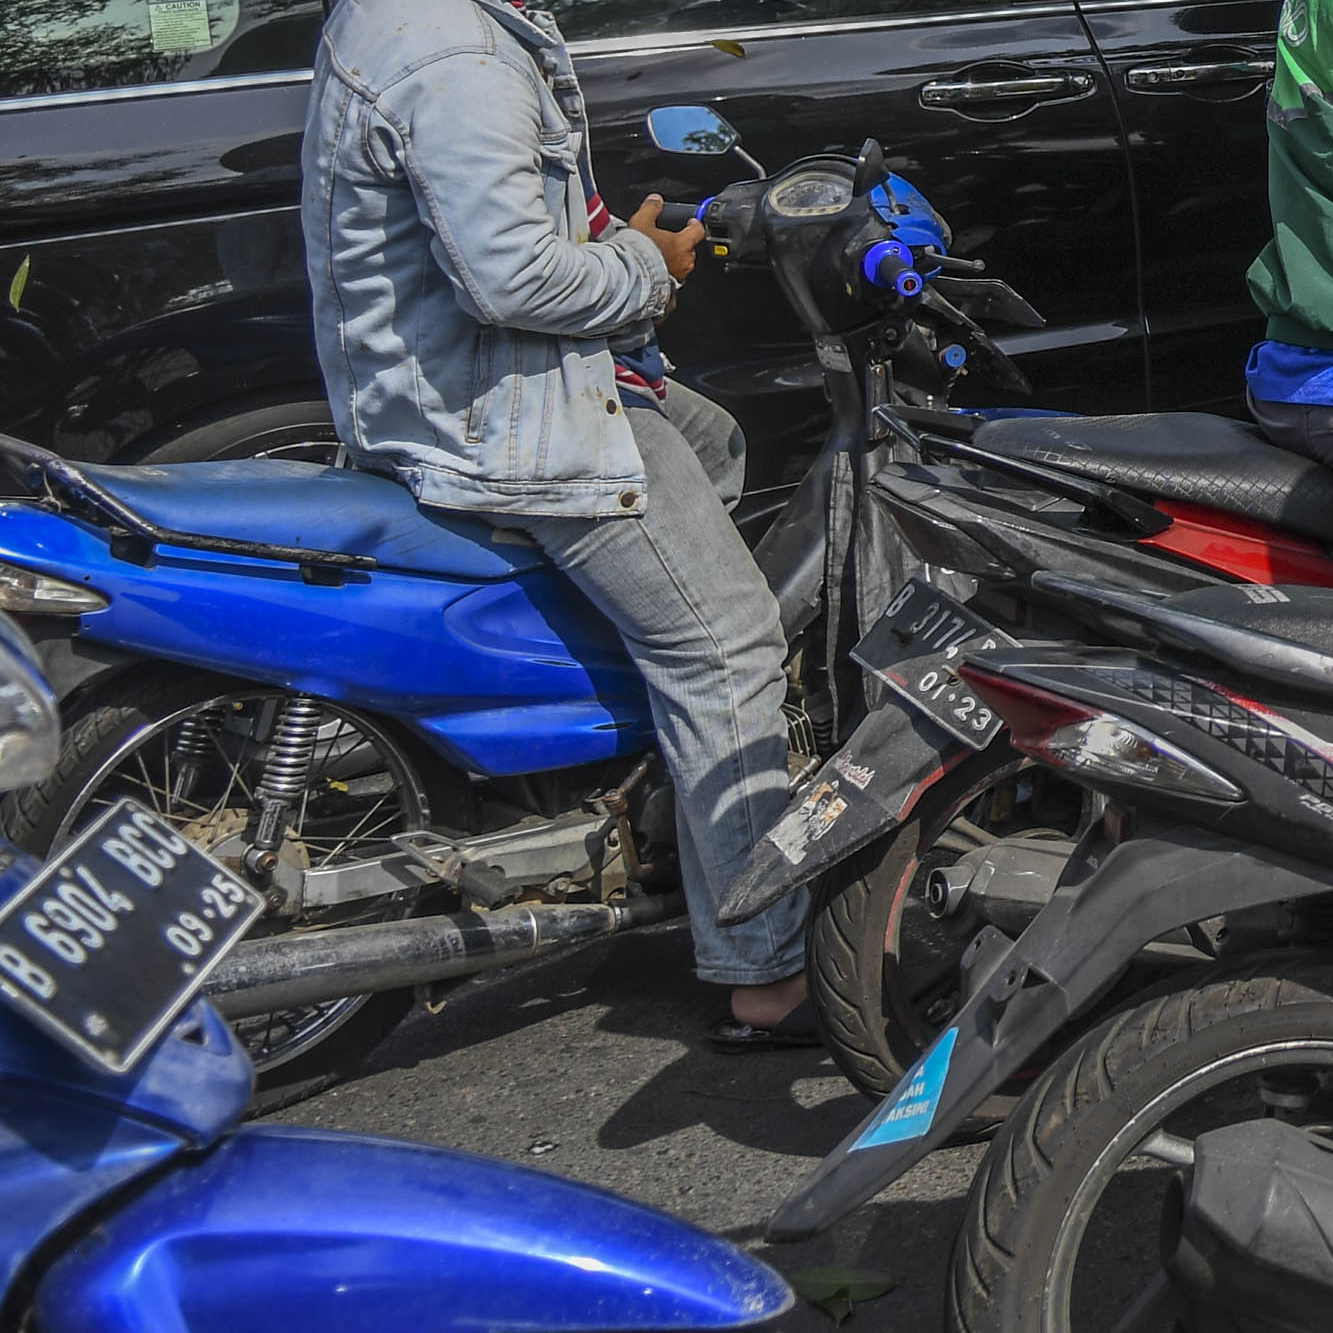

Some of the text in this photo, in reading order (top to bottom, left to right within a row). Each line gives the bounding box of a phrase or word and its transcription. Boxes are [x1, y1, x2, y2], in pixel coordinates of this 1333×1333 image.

[886, 584, 916, 617] B
[0, 812, 188, 999] B 6904 BCC
